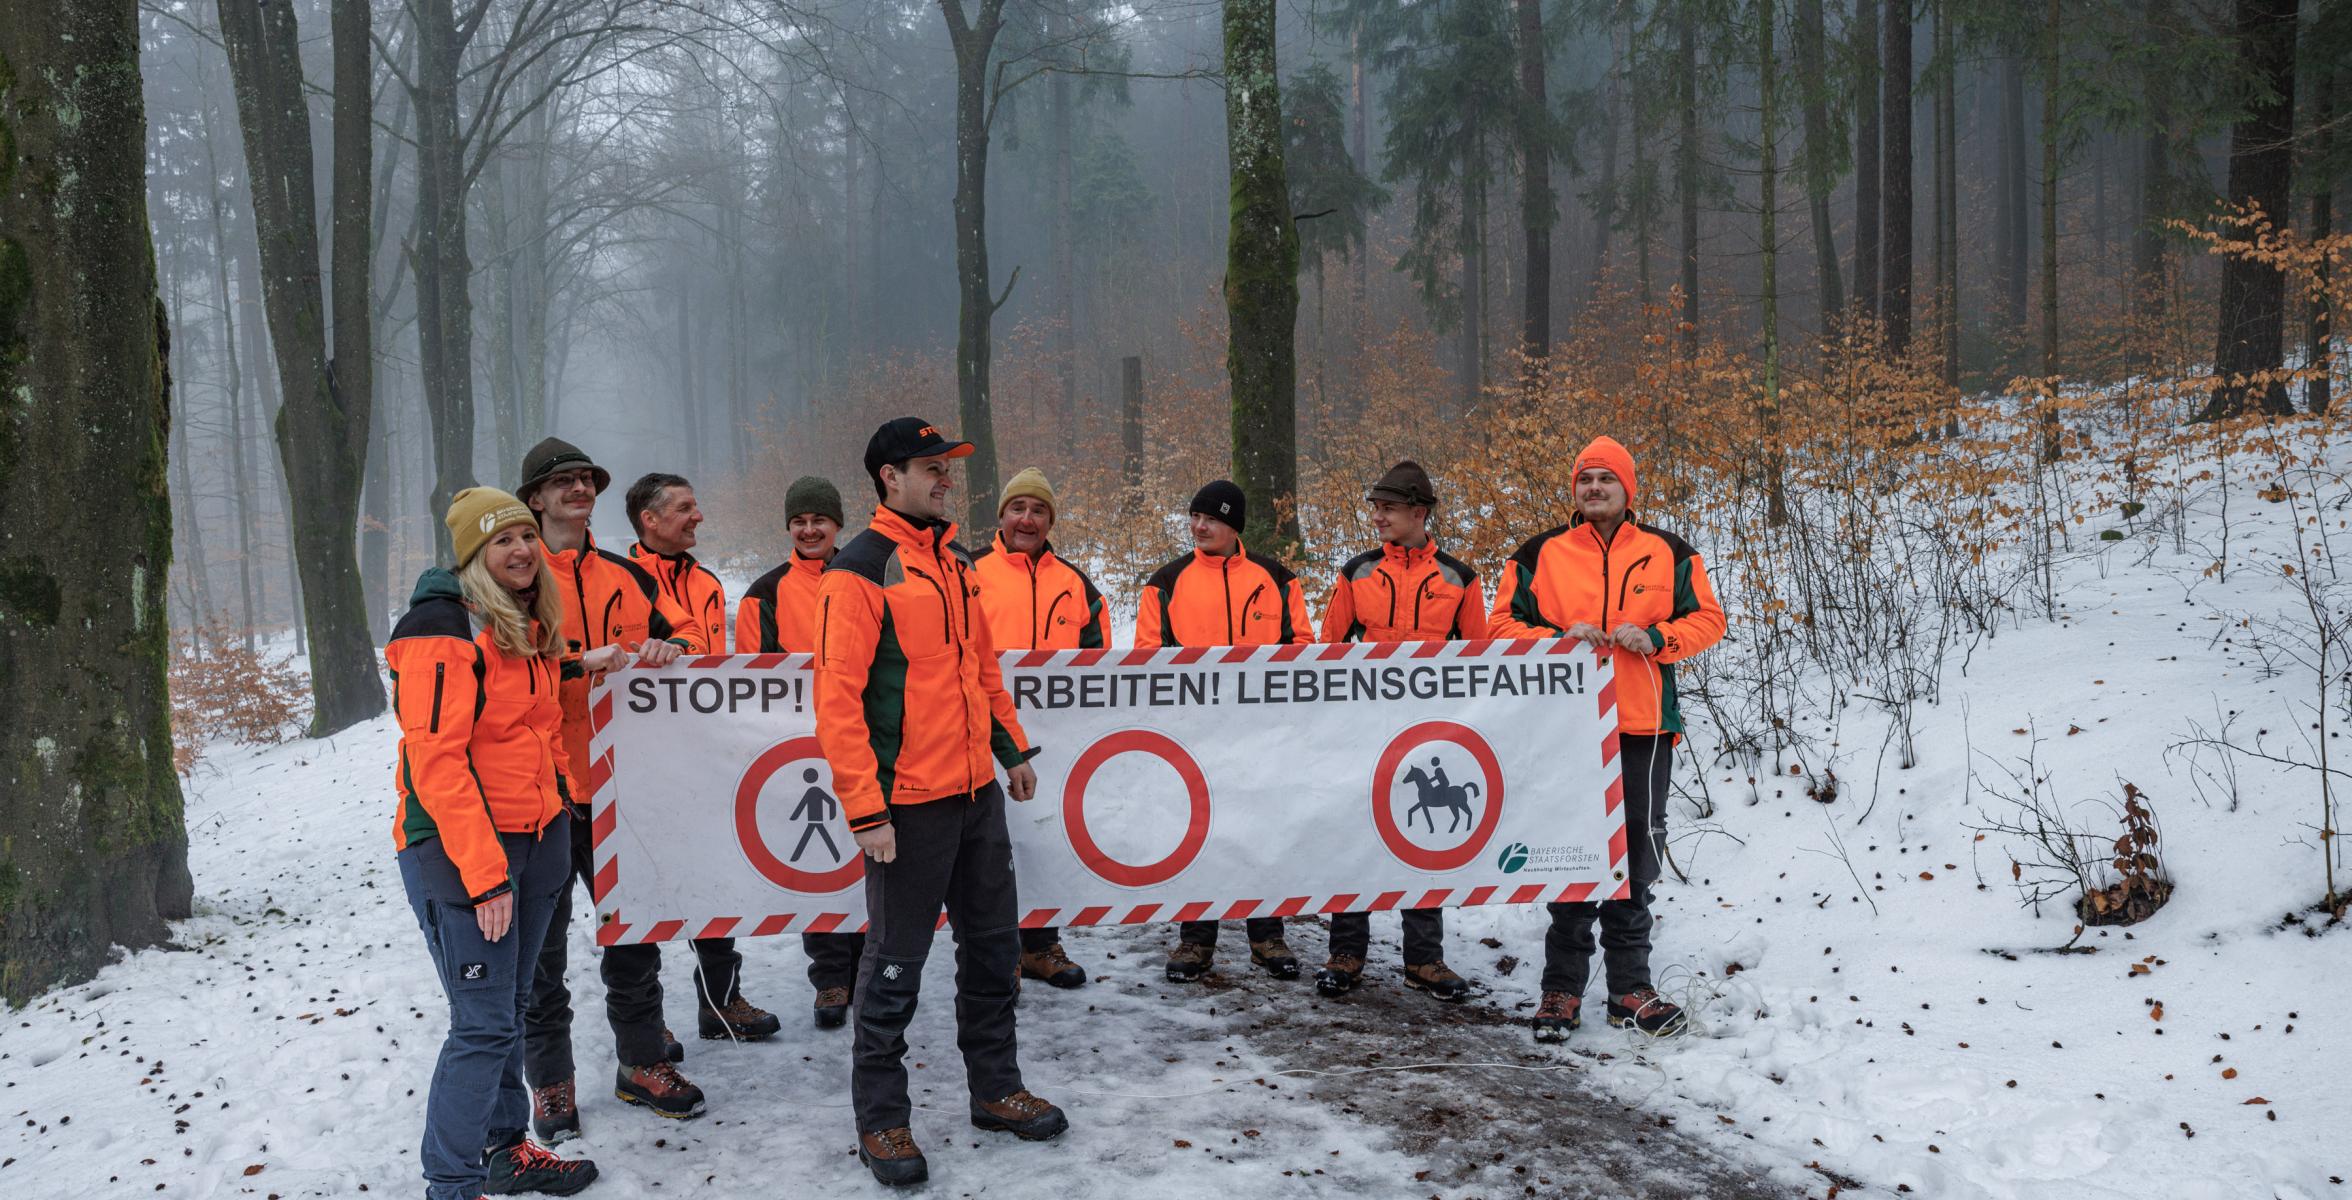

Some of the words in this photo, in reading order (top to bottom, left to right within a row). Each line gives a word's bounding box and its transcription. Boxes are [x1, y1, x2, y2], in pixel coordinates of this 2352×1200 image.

[628, 677, 803, 714] STOPP!
[1013, 672, 1220, 710] RBEITEN!
[1237, 662, 1585, 704] LEBENSGEFAHR!
[1530, 845, 1584, 855] BAYERISCHE
[1528, 854, 1600, 864] STAATSFORSTEN
